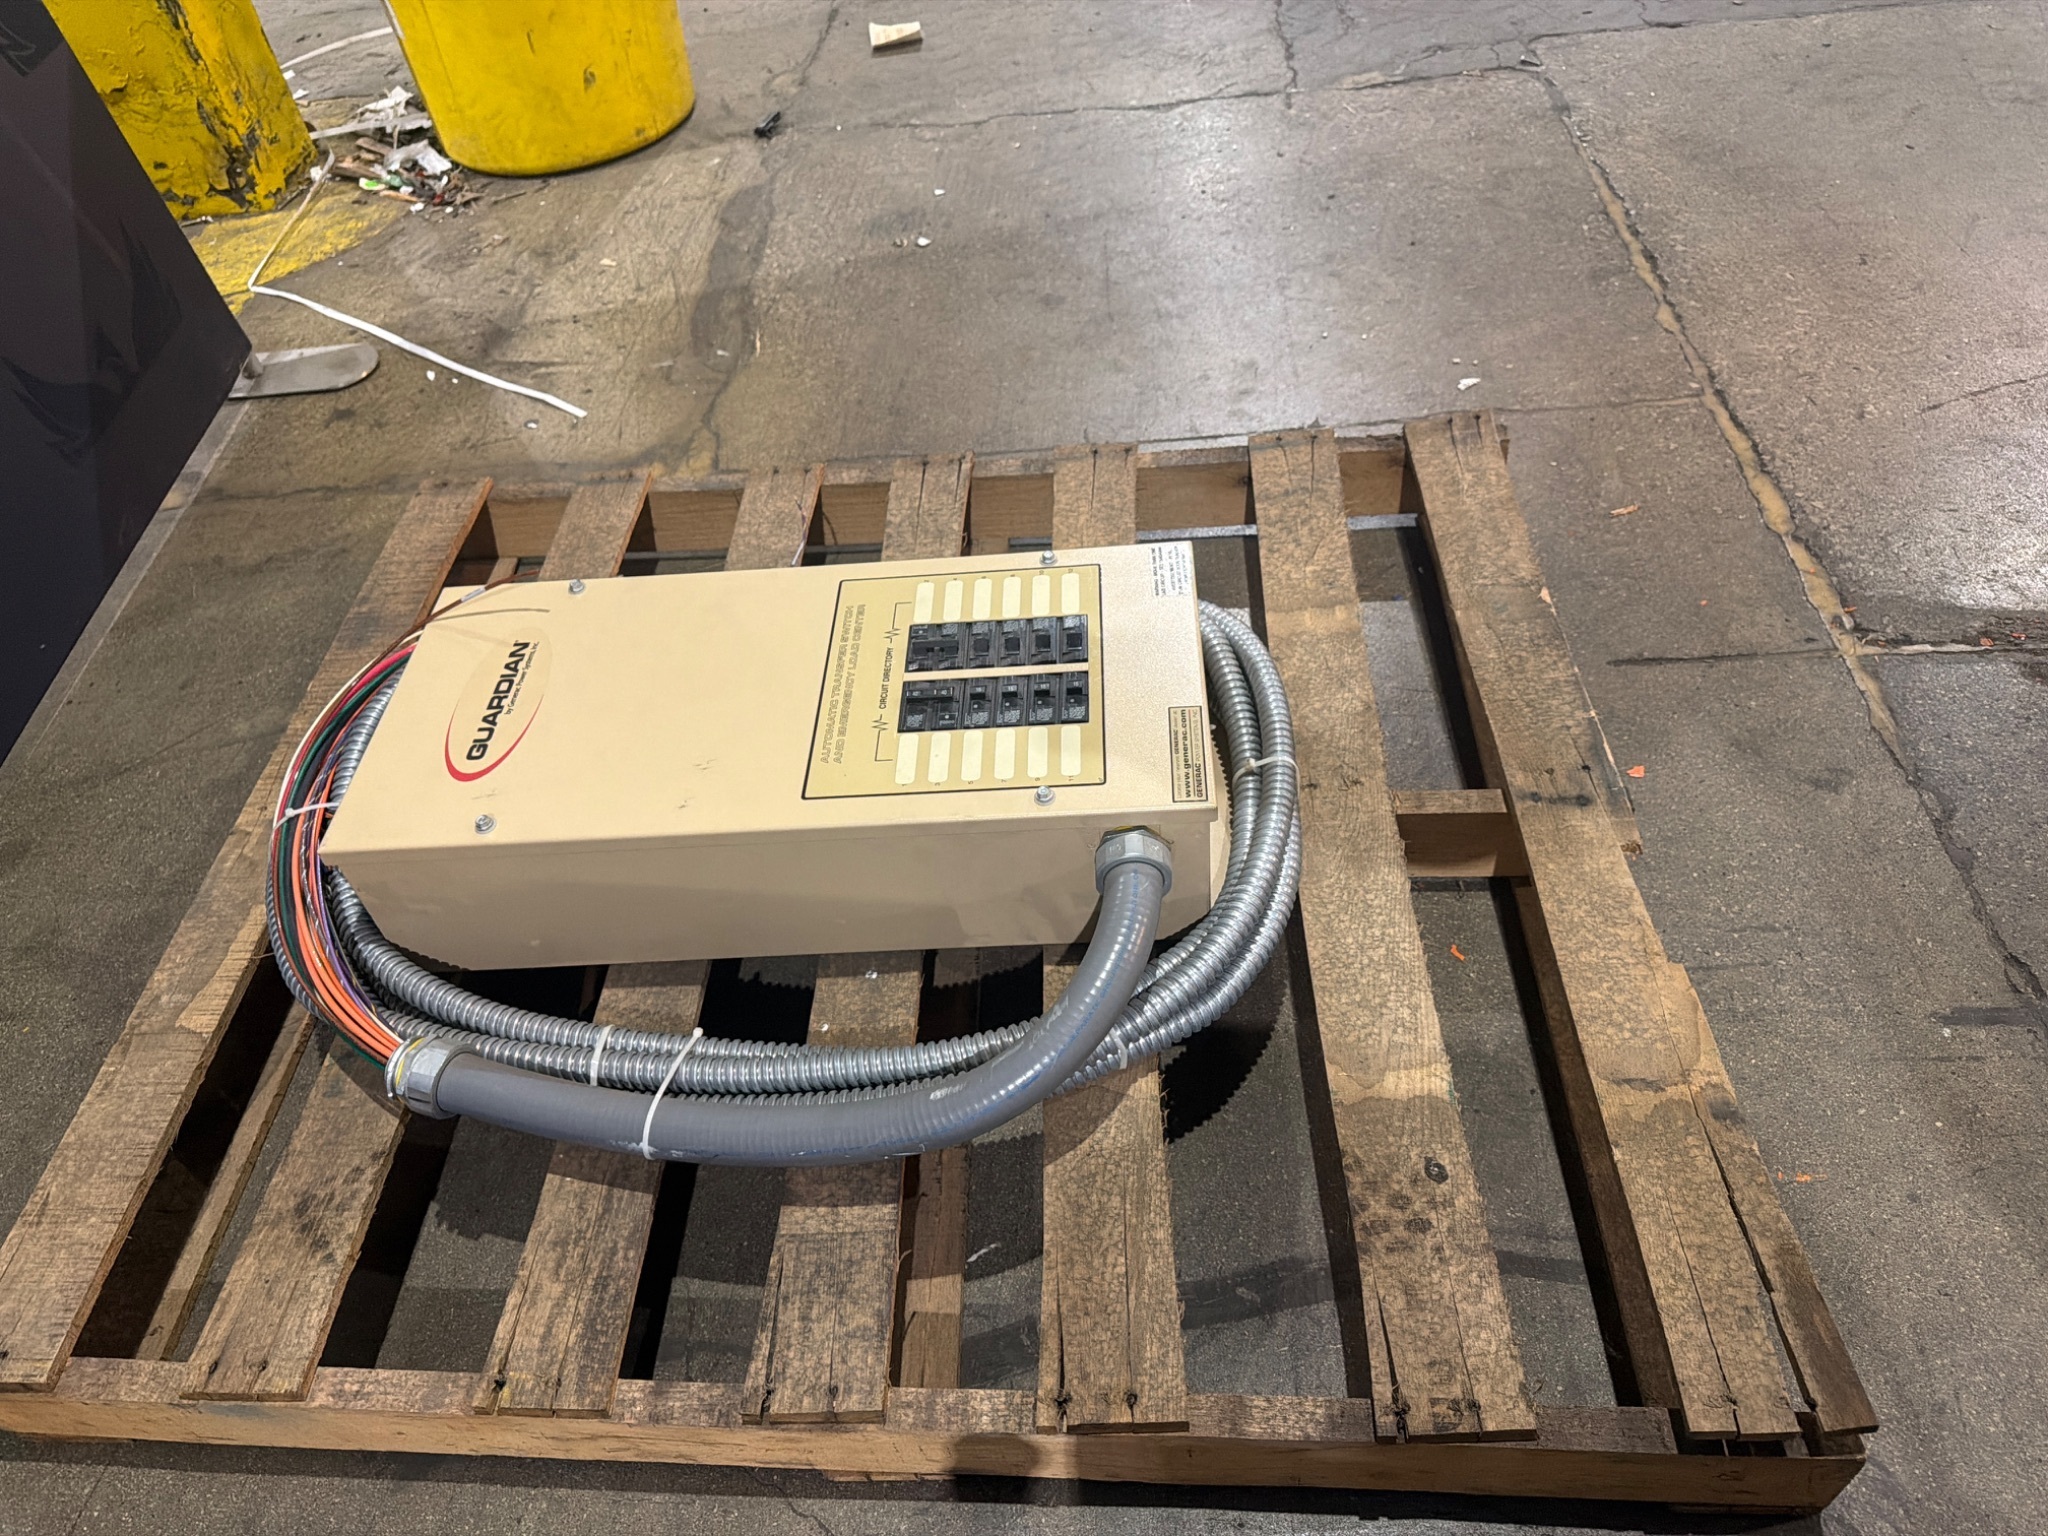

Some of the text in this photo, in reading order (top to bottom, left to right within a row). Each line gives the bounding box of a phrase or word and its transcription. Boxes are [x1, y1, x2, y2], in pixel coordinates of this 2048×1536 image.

[466, 642, 530, 761] GUARDIAN
[508, 686, 522, 707] Generac
[516, 670, 528, 686] Power
[820, 605, 854, 763] AUTOMATIC TRANSFER SWITCH
[833, 604, 866, 764] AND EMERGENCY LOAD CENTER
[878, 646, 894, 709] CIRCUIT DIRECTORY
[1180, 709, 1191, 798] www.generac.com
[1195, 763, 1203, 798] GENERAC
